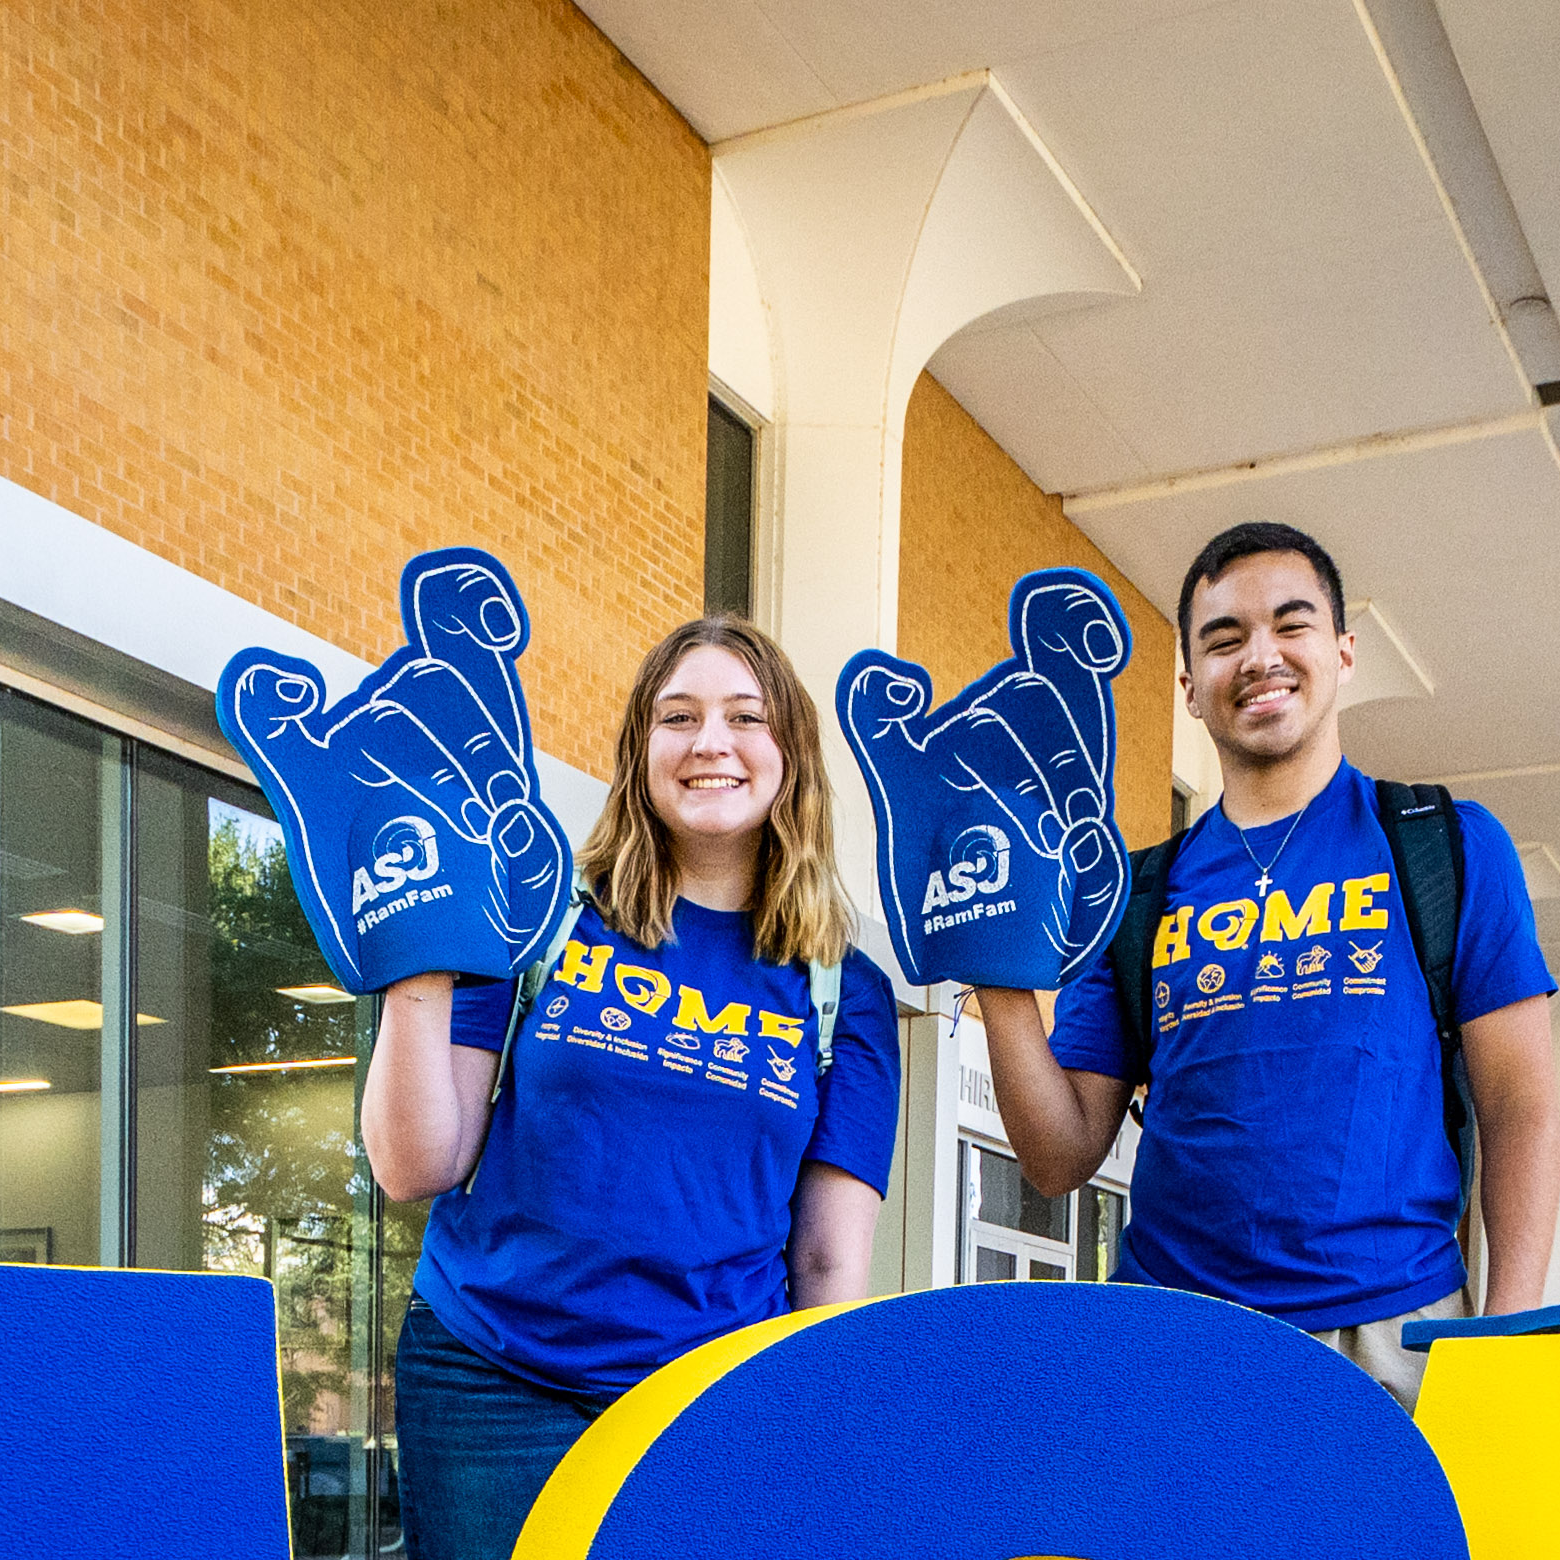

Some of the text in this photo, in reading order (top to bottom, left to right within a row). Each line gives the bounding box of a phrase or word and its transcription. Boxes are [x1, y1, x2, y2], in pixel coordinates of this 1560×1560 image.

[351, 815, 440, 916] ASU
[357, 884, 454, 935] #RamFam
[921, 824, 1011, 915] ASU
[923, 899, 1017, 935] #RamFam
[1151, 872, 1390, 970] HOME
[553, 939, 805, 1049] HOME
